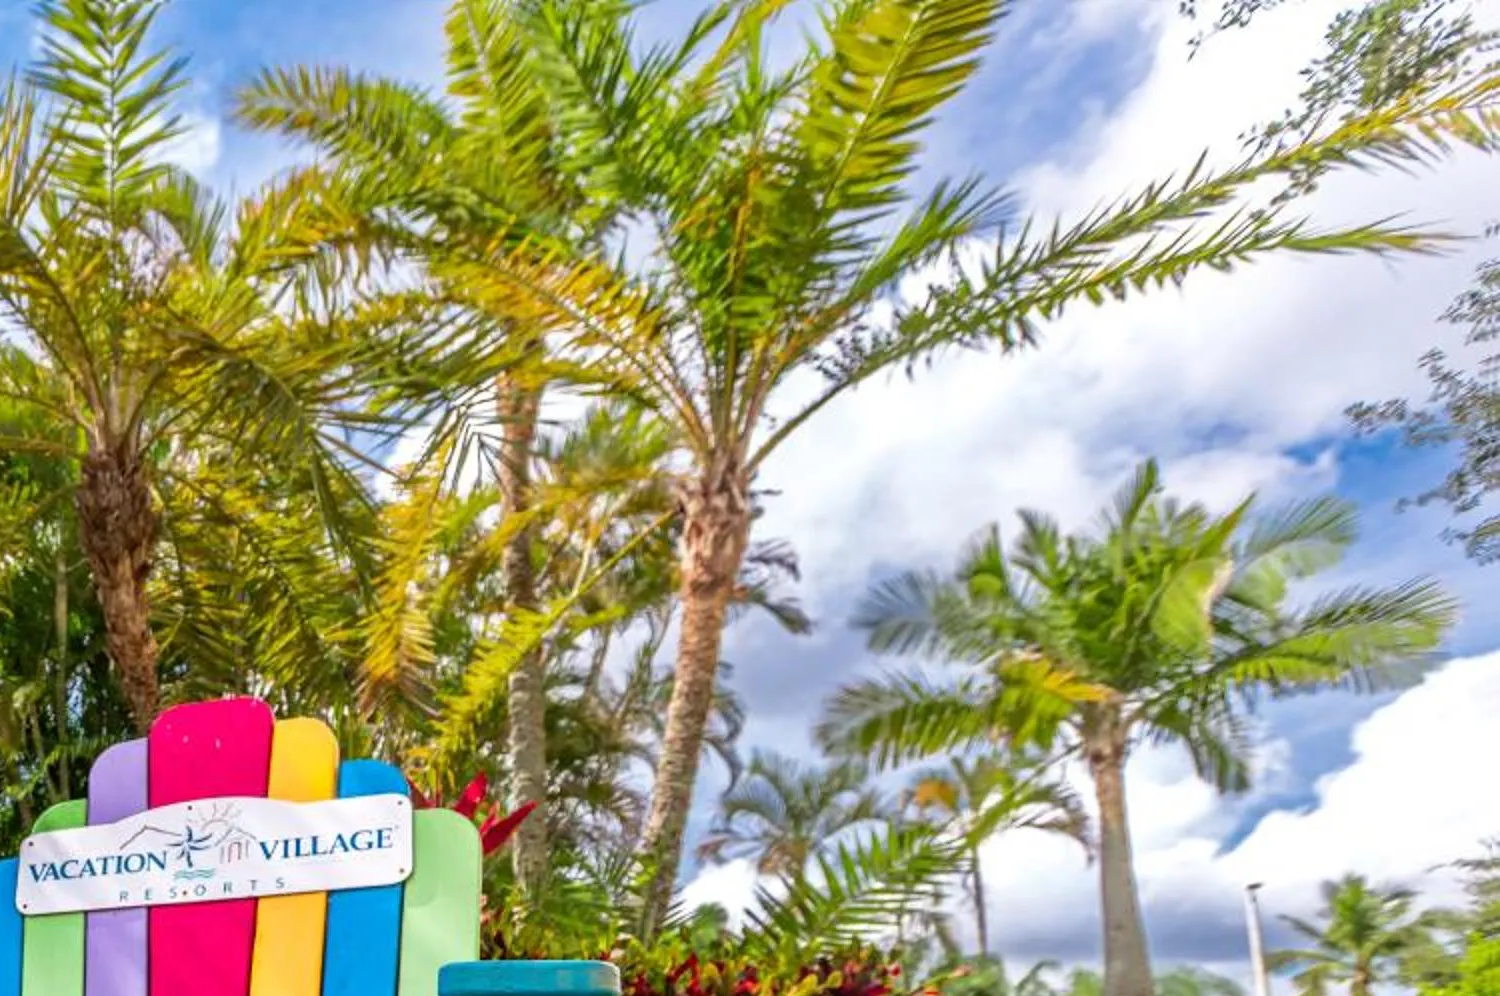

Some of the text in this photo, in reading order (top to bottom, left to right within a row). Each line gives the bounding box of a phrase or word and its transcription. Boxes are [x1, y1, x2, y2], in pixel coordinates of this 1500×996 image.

[29, 827, 394, 882] VACATION VILLAGE
[119, 877, 286, 902] RESORTS
